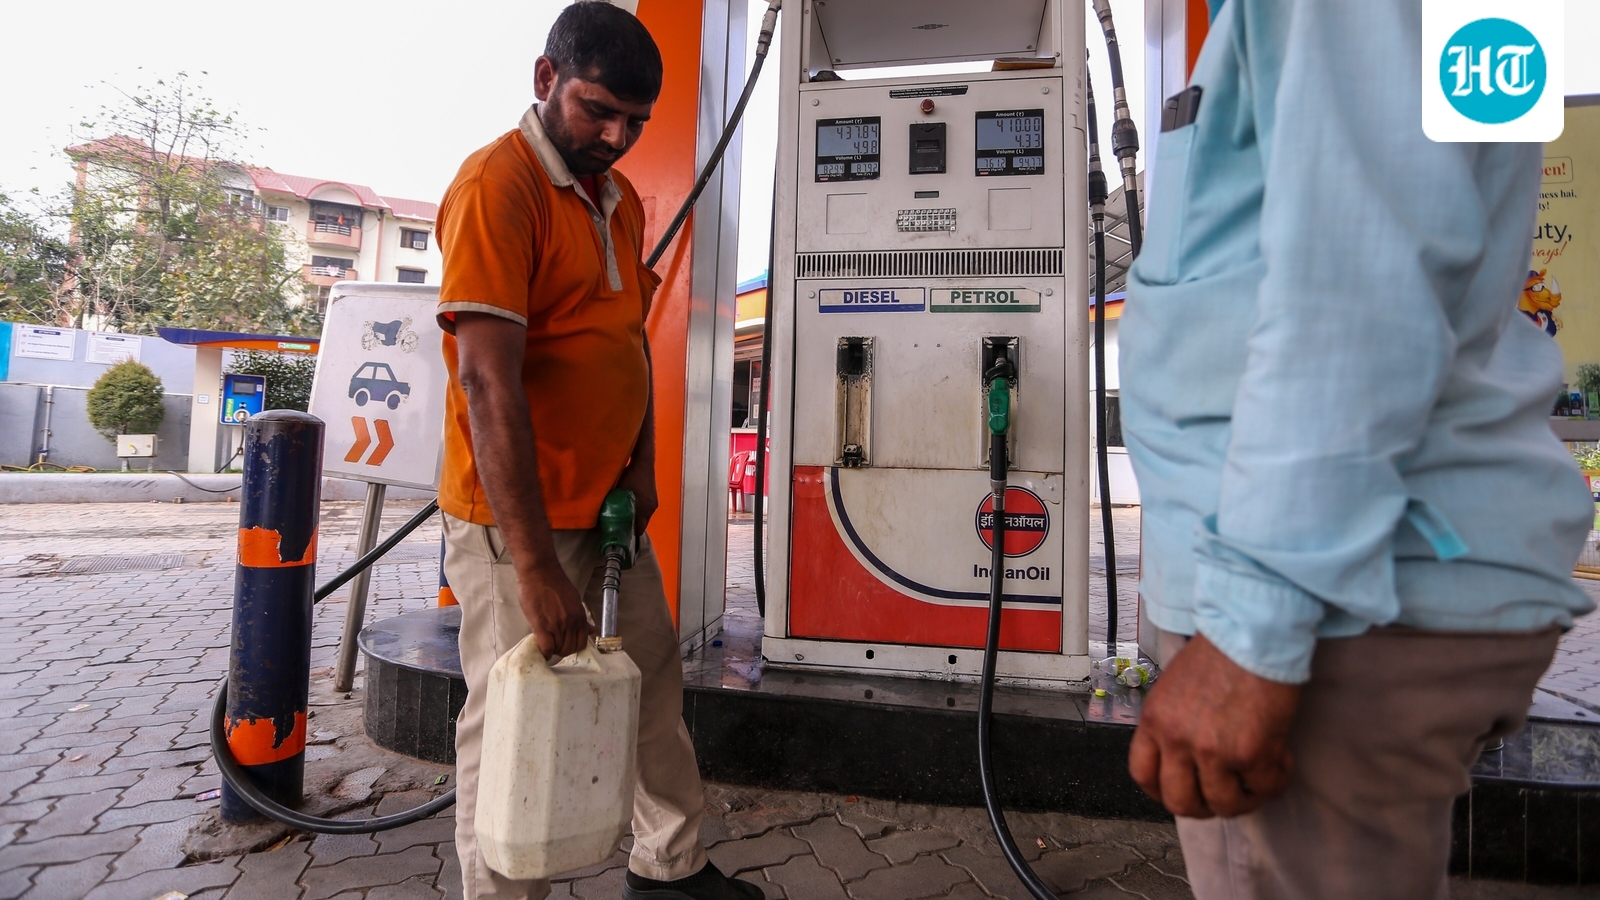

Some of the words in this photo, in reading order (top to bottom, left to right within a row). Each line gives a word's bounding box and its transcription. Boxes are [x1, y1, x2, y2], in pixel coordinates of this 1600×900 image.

[837, 125, 877, 139] 437.84
[997, 118, 1040, 132] 410.00
[854, 140, 877, 154] 4.98
[1015, 133, 1040, 147] 4.33
[1541, 162, 1566, 176] en!
[1538, 202, 1550, 211] ty!
[1533, 222, 1572, 243] uty,
[843, 291, 899, 304] DIESEL
[951, 291, 1020, 304] PETROL
[973, 564, 1050, 581] InanOil
